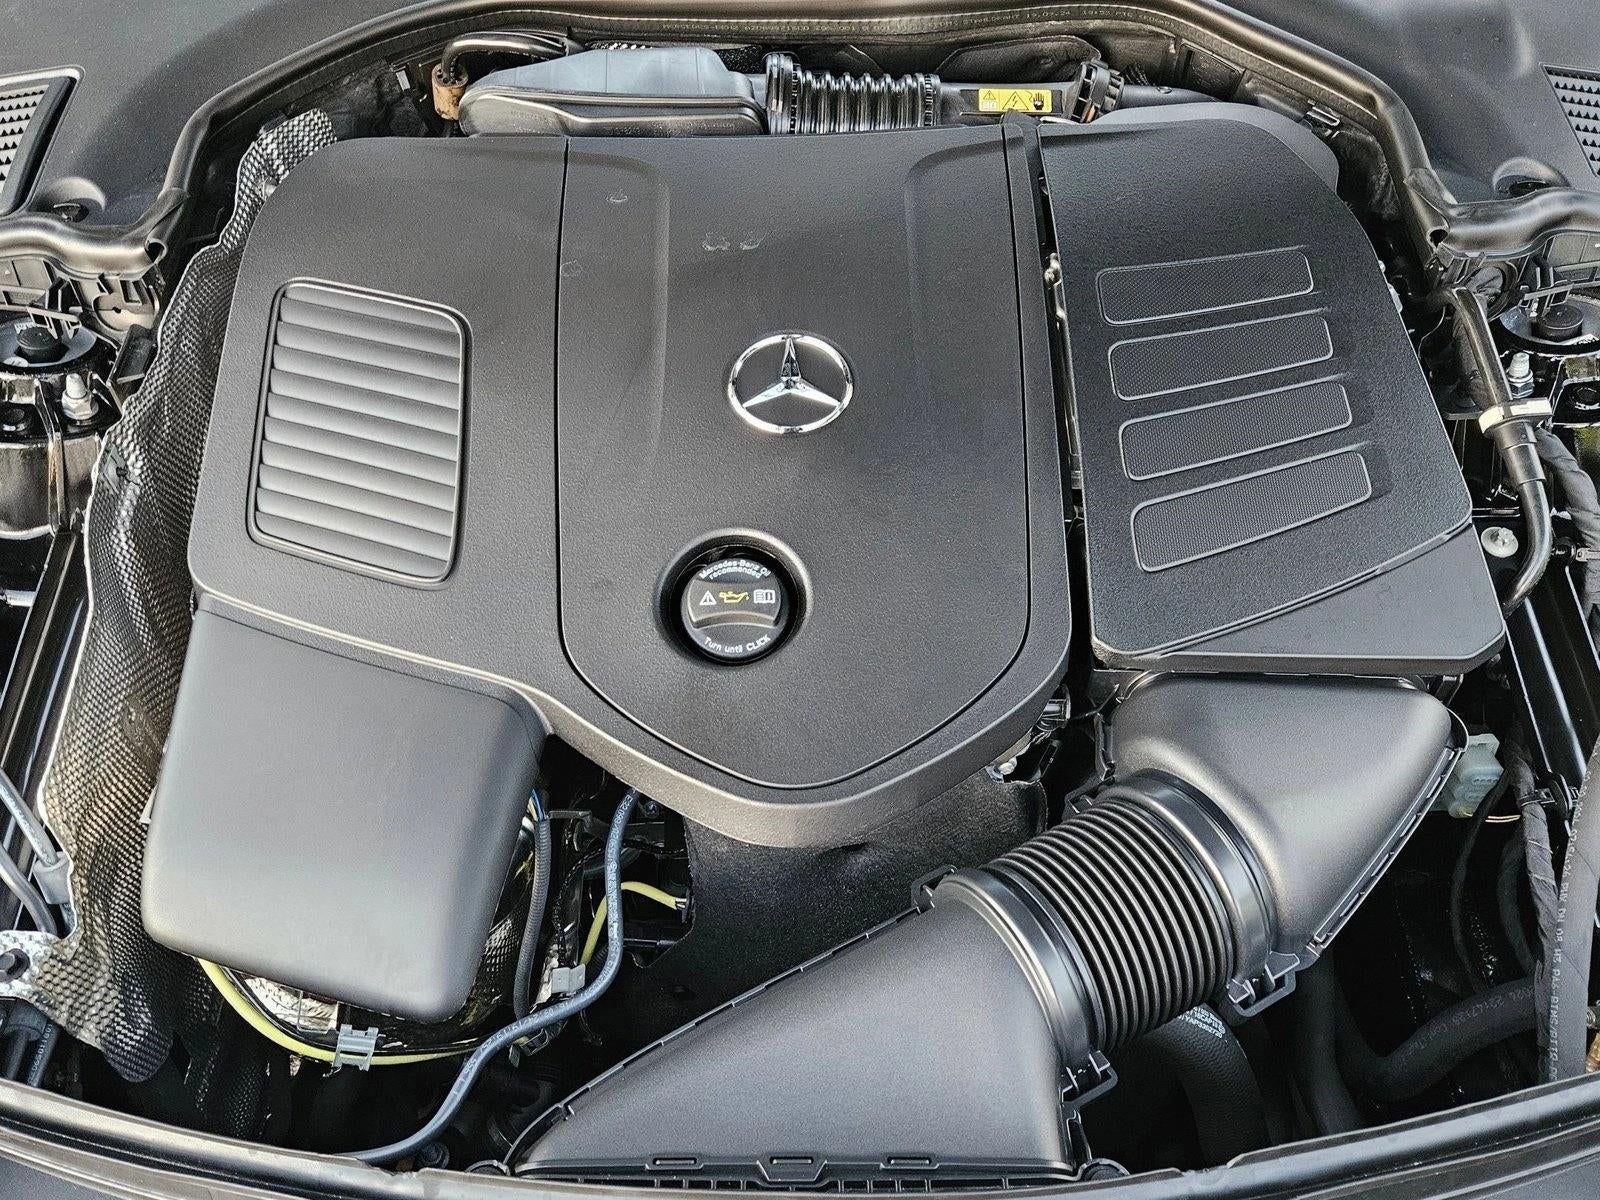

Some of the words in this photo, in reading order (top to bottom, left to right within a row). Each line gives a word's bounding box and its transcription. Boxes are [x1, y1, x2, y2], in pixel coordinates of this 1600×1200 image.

[698, 559, 758, 579] Mercedes-Benz
[760, 566, 771, 577] Oil
[709, 567, 762, 580] recommended
[704, 636, 722, 651] Turn
[724, 644, 743, 653] until
[746, 635, 771, 652] CLICK
